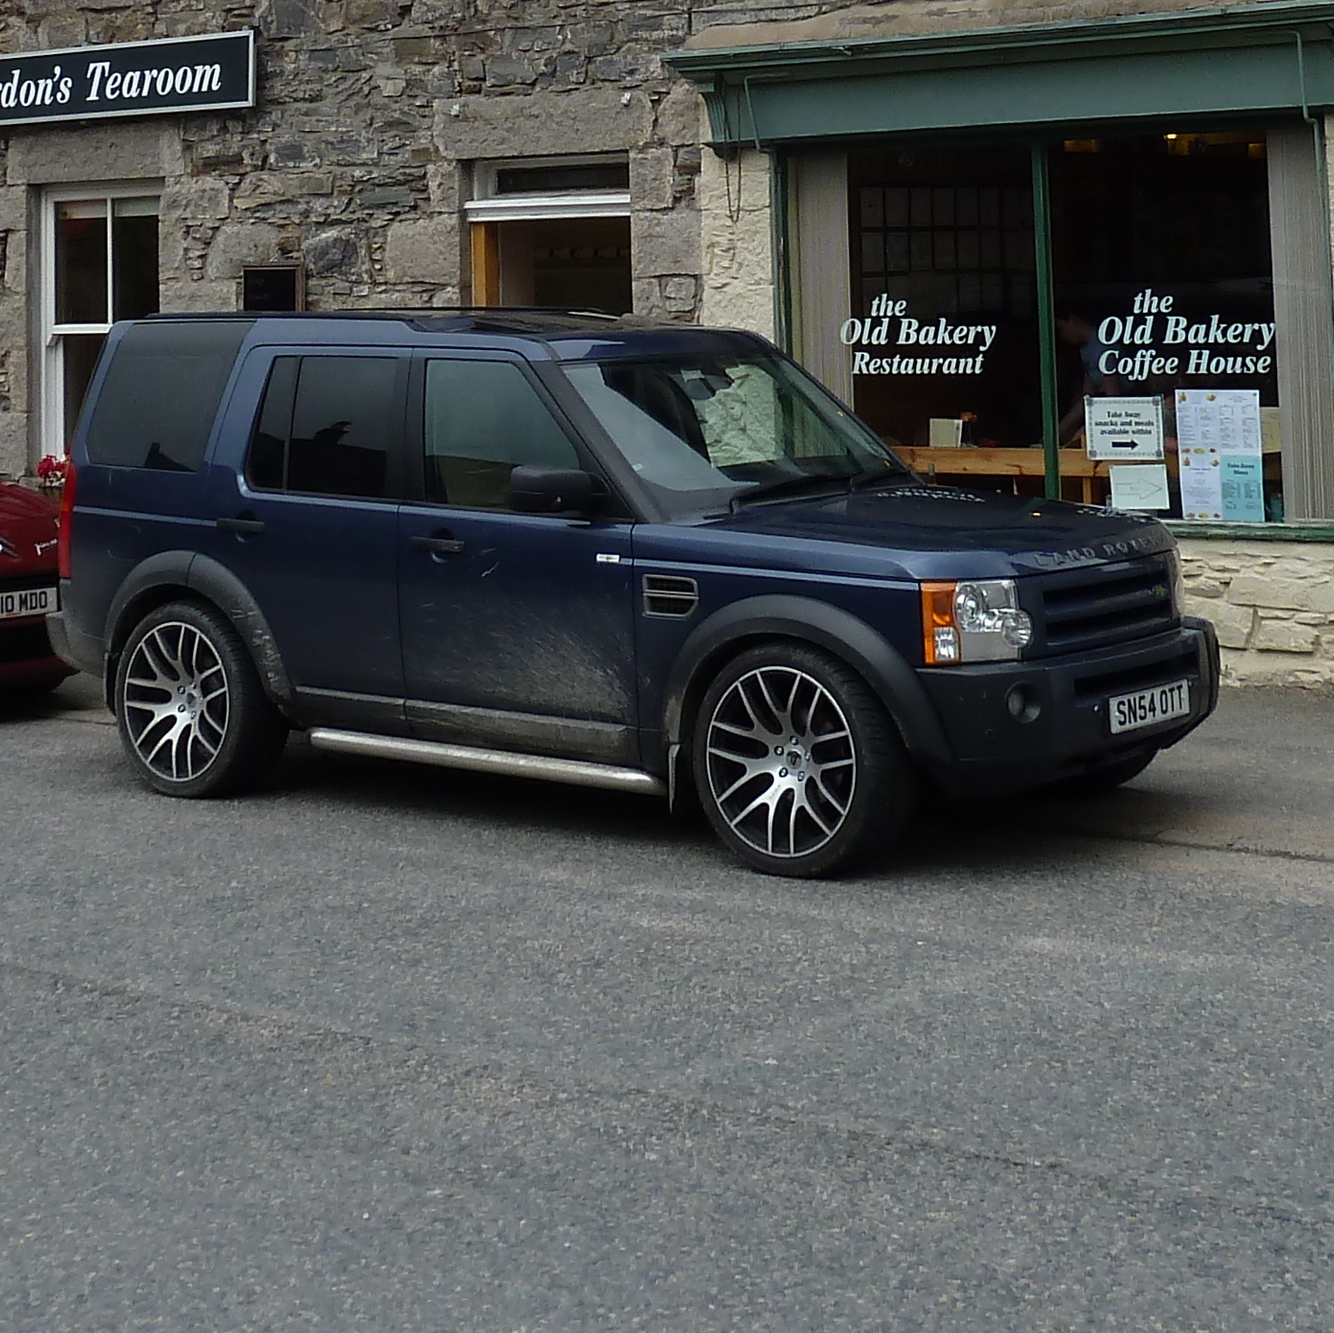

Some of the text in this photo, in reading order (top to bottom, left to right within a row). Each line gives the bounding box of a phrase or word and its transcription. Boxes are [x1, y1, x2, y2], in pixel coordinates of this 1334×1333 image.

[85, 61, 222, 102] Tearoom
[870, 293, 907, 316] the
[1133, 288, 1174, 314] the
[839, 317, 997, 352] Old Bakery
[1097, 314, 1276, 351] Old Bakery
[852, 351, 985, 375] Restaurant
[1098, 349, 1272, 381] Coffee House
[1033, 547, 1096, 566] LAND
[18, 590, 48, 611] MDO
[1116, 684, 1183, 726] SN54 OTT
